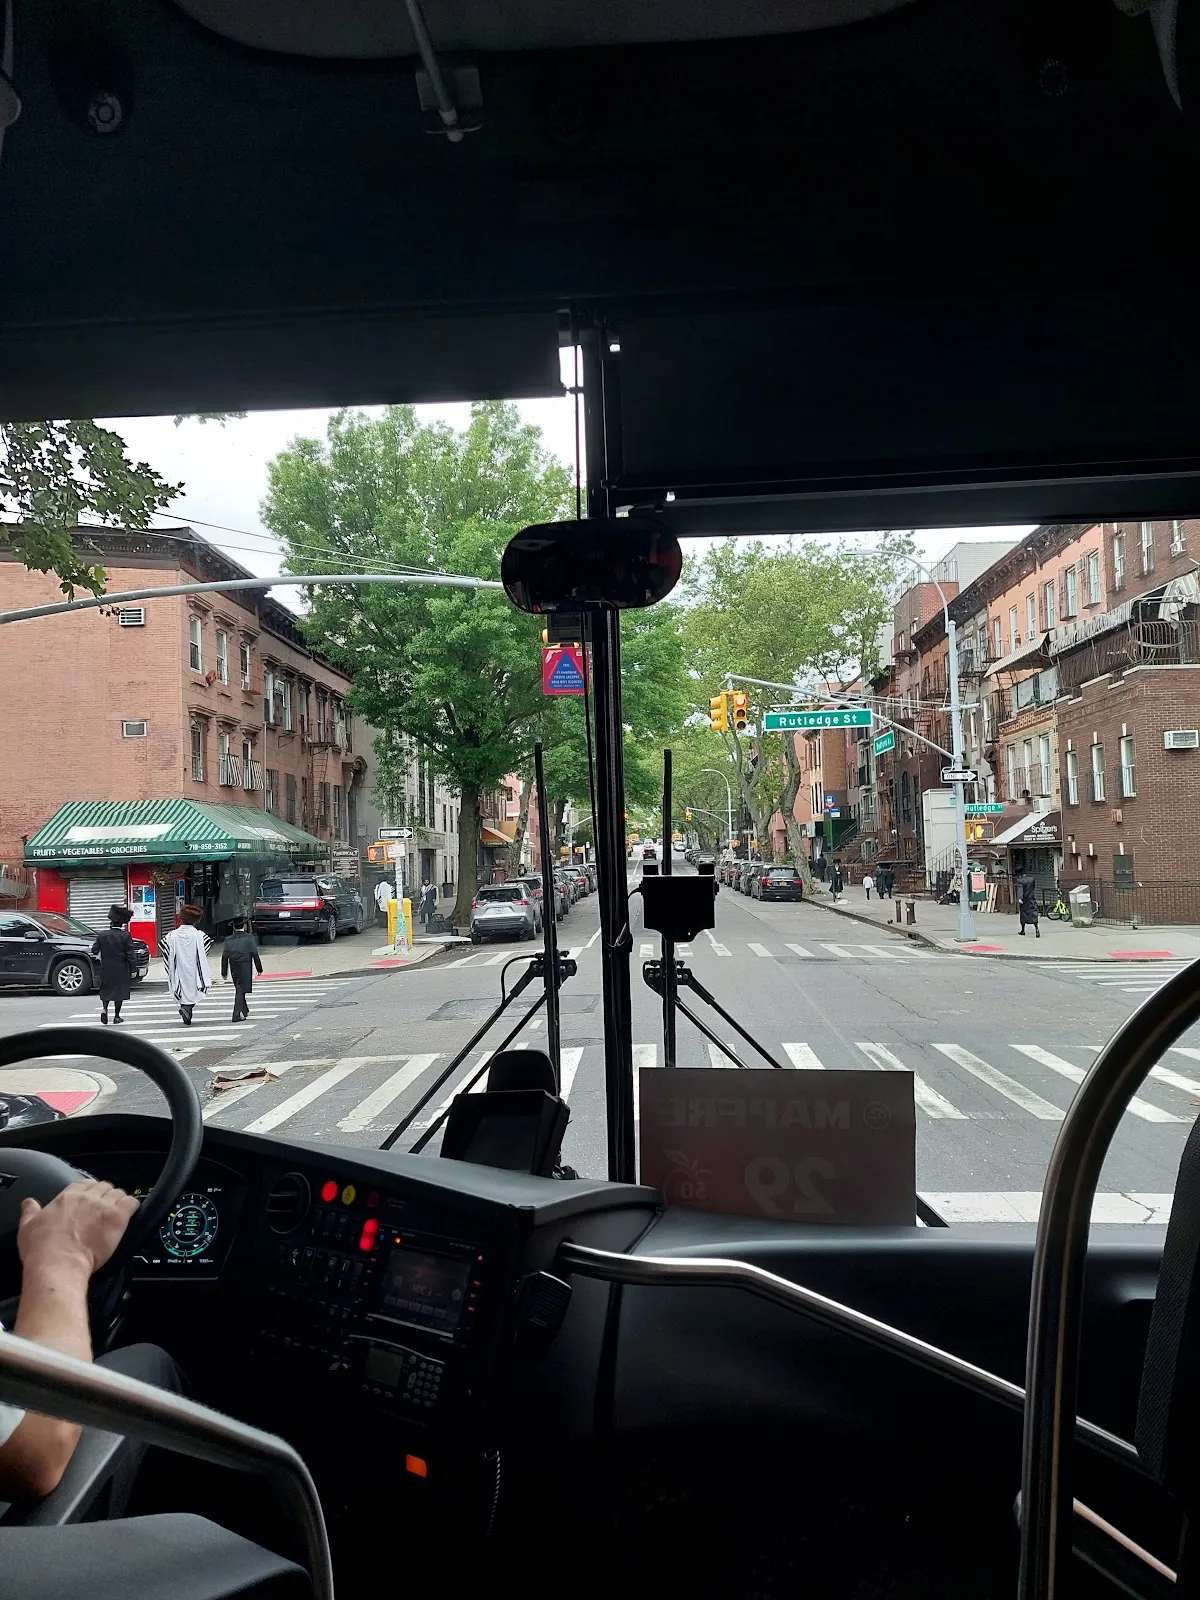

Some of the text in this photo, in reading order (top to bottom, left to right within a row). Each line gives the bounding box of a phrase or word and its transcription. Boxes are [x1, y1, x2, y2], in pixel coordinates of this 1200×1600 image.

[779, 714, 858, 727] Rutledge St
[965, 804, 996, 813] Rutledge
[33, 845, 148, 857] FRUITS VEGETABLES GROCERIES
[188, 842, 228, 851] 718-858-3152
